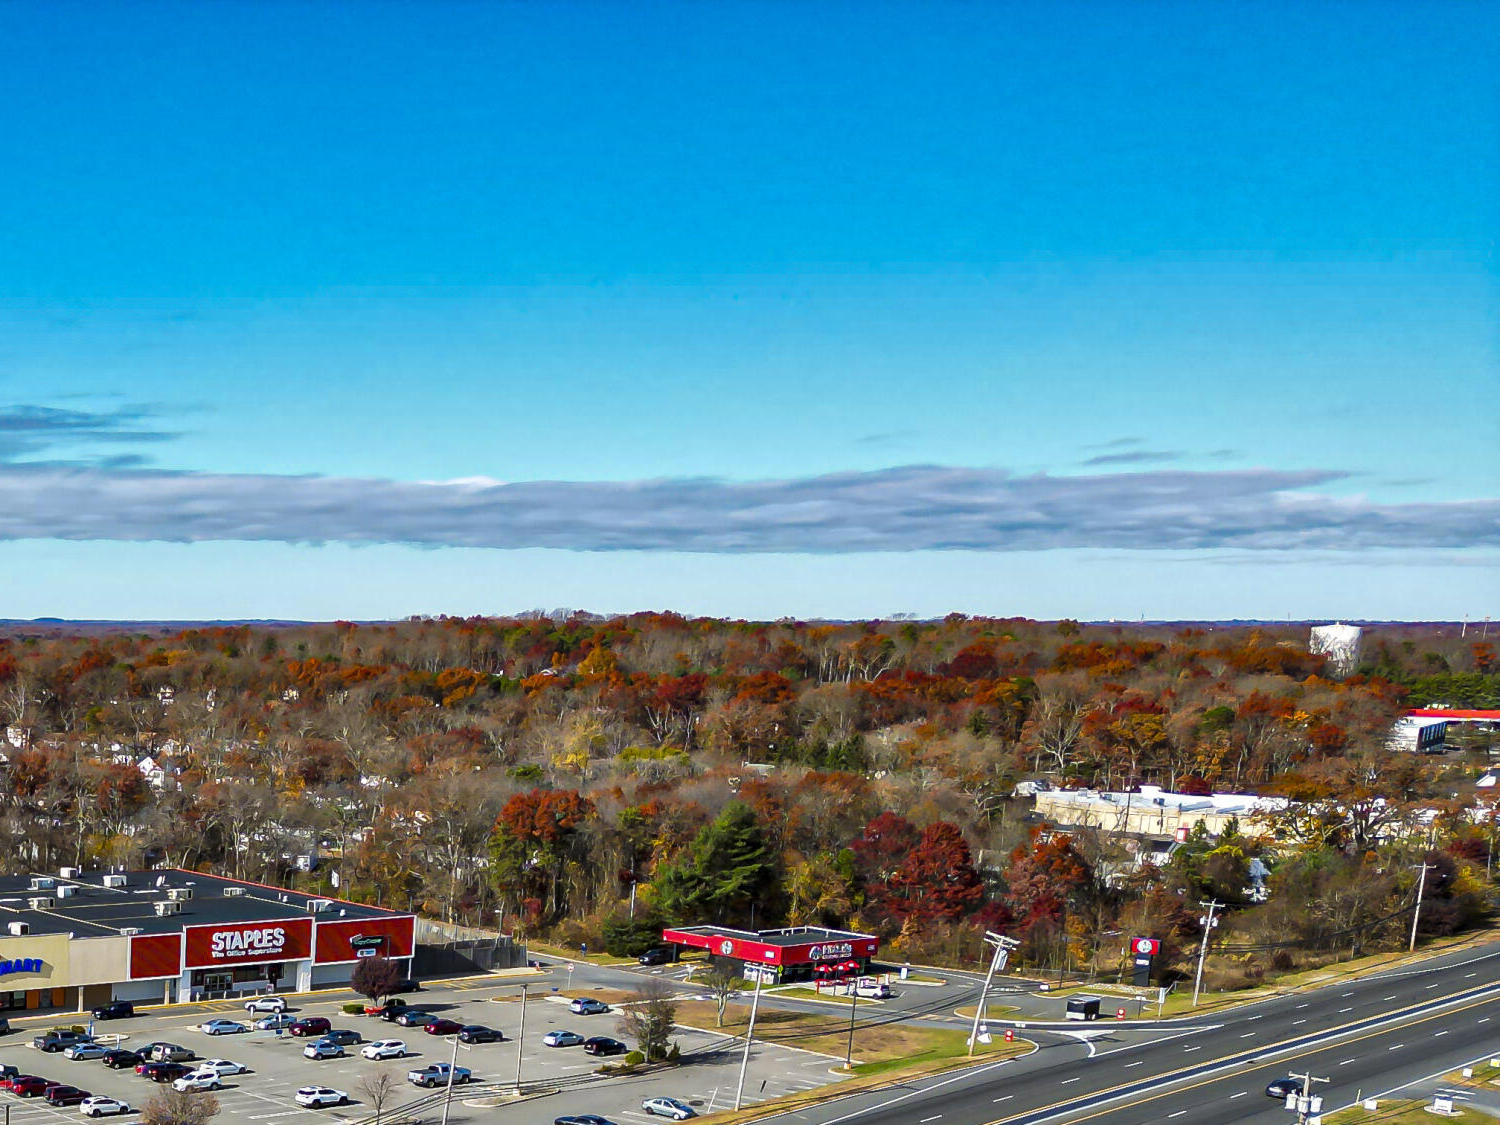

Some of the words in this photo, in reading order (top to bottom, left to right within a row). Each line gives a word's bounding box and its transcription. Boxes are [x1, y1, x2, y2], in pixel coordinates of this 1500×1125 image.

[212, 928, 285, 951] STAPLES
[227, 949, 246, 957] Office
[248, 947, 283, 956] Superstore
